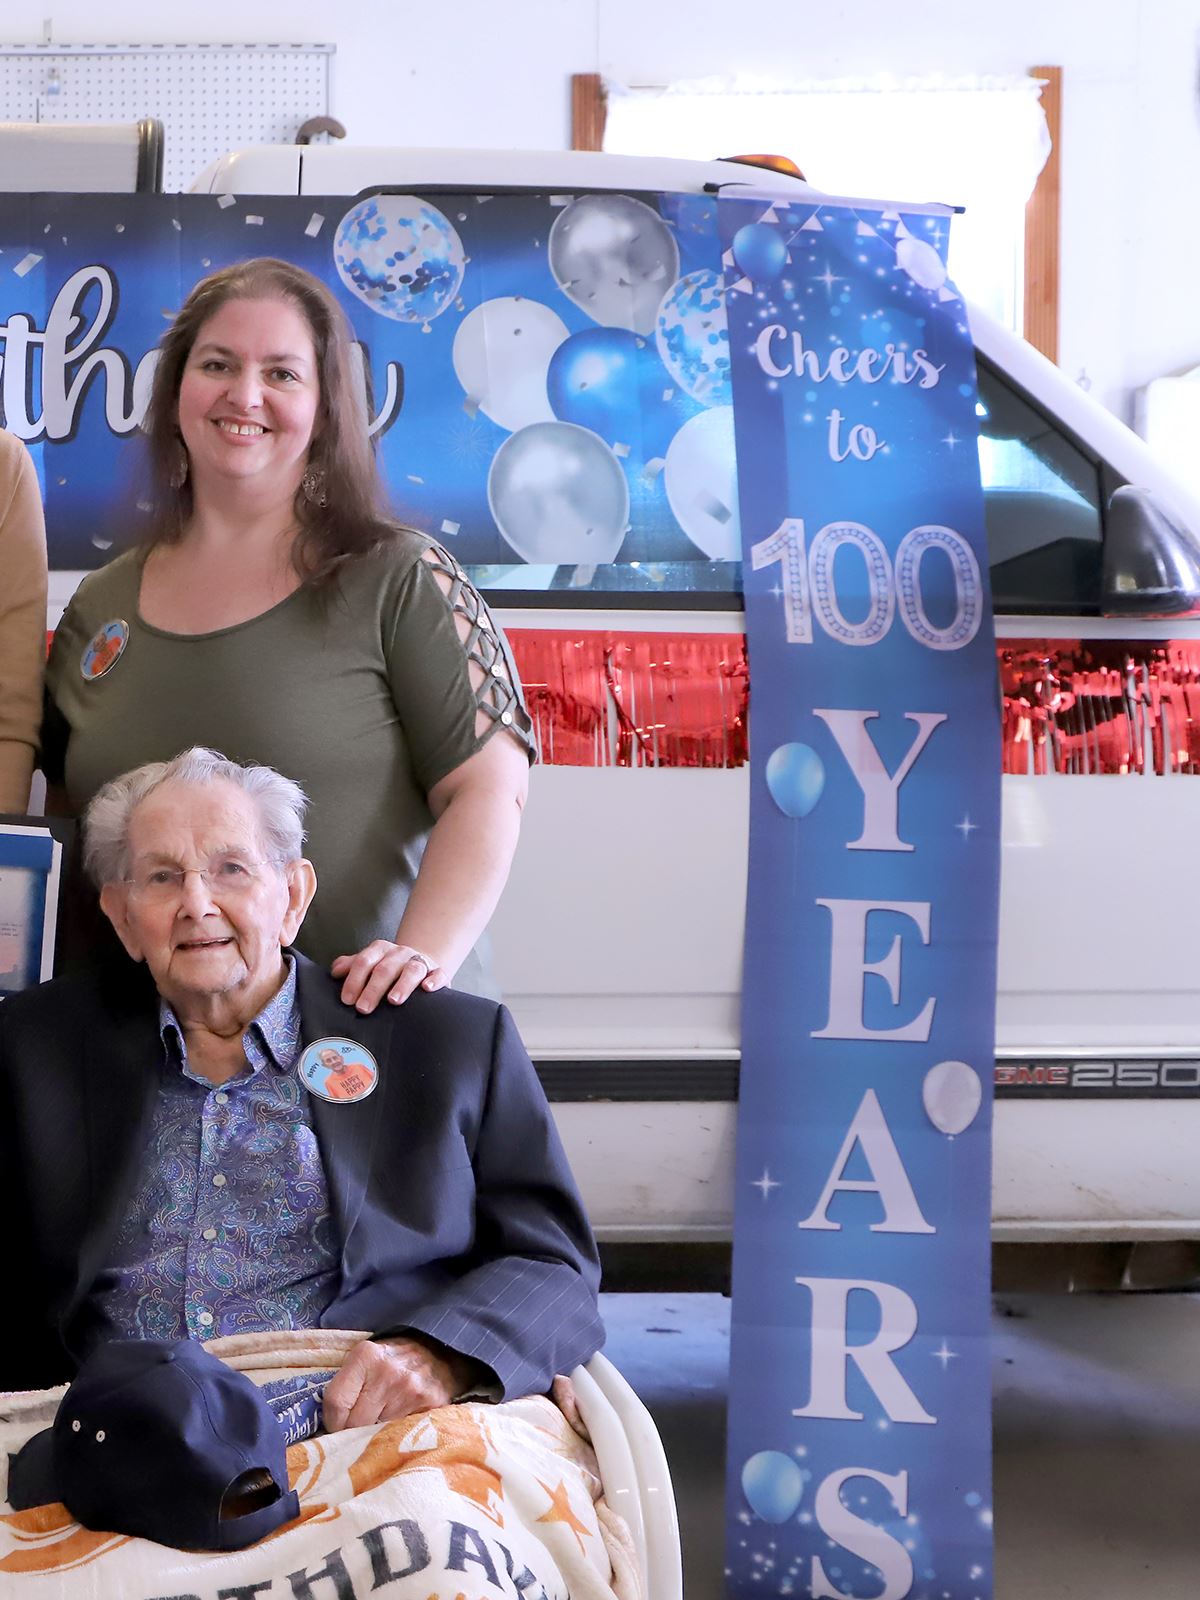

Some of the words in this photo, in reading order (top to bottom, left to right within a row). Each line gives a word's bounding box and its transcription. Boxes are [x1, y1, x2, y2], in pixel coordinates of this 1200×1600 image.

[755, 323, 946, 390] Cheers
[826, 408, 886, 463] to
[751, 518, 984, 651] 100
[340, 1074, 361, 1089] HAPPY
[345, 1081, 366, 1097] PAPPY
[994, 1066, 1069, 1085] GMC
